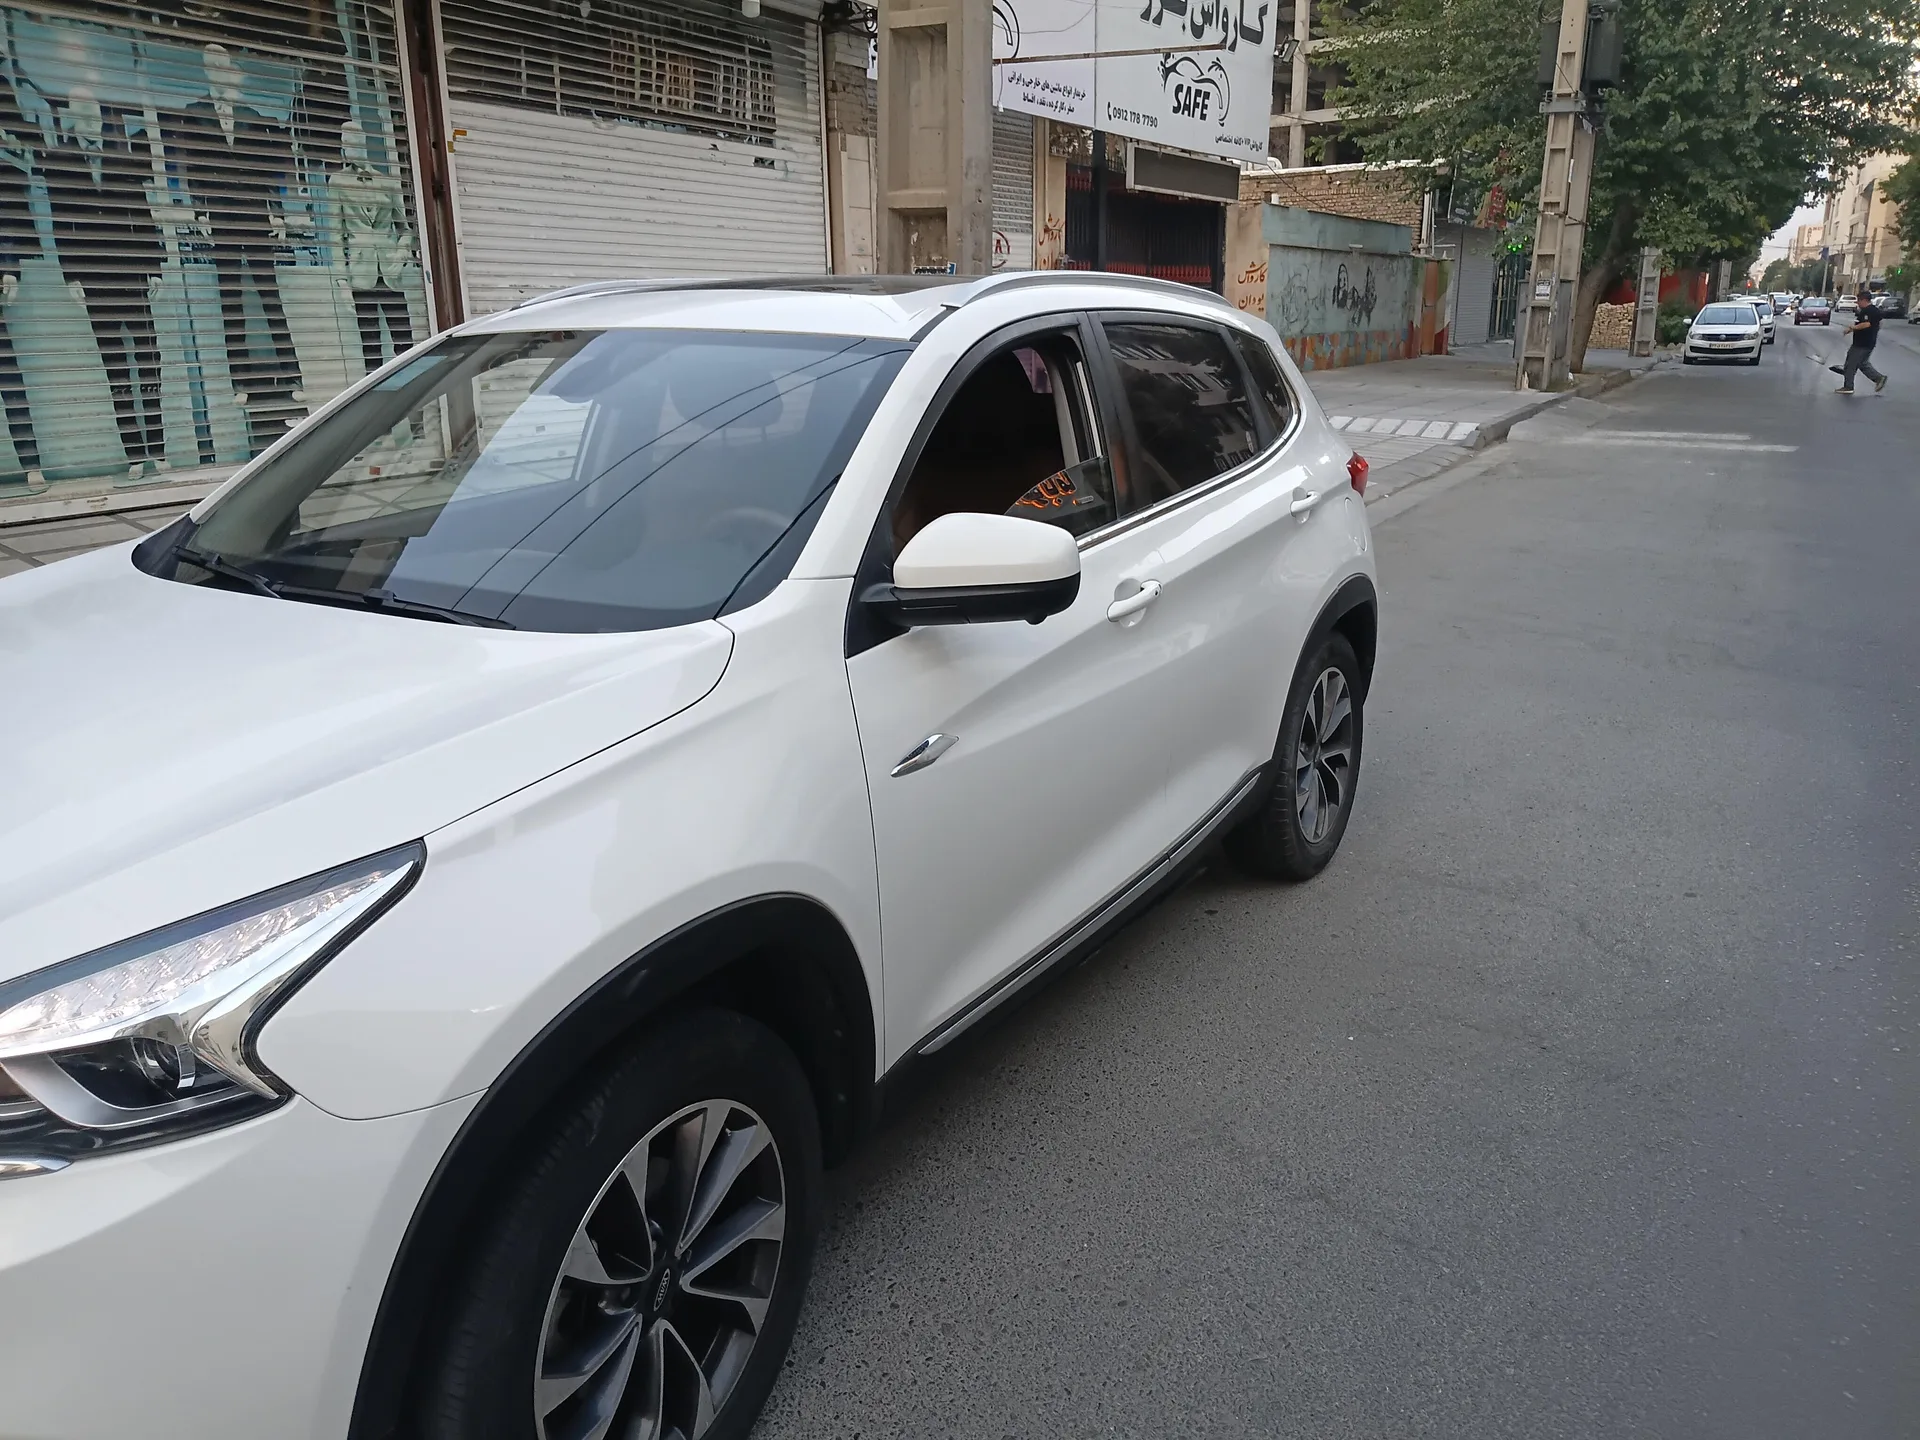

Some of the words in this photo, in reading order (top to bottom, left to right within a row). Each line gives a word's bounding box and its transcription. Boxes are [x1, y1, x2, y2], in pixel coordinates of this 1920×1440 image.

[1050, 82, 1062, 94] ماشین
[1062, 85, 1073, 98] انواع
[1172, 83, 1211, 121] SAFE
[1112, 106, 1128, 121] 0912
[1129, 110, 1141, 124] 178
[1141, 114, 1158, 128] 7790
[1237, 261, 1268, 284] کارواش
